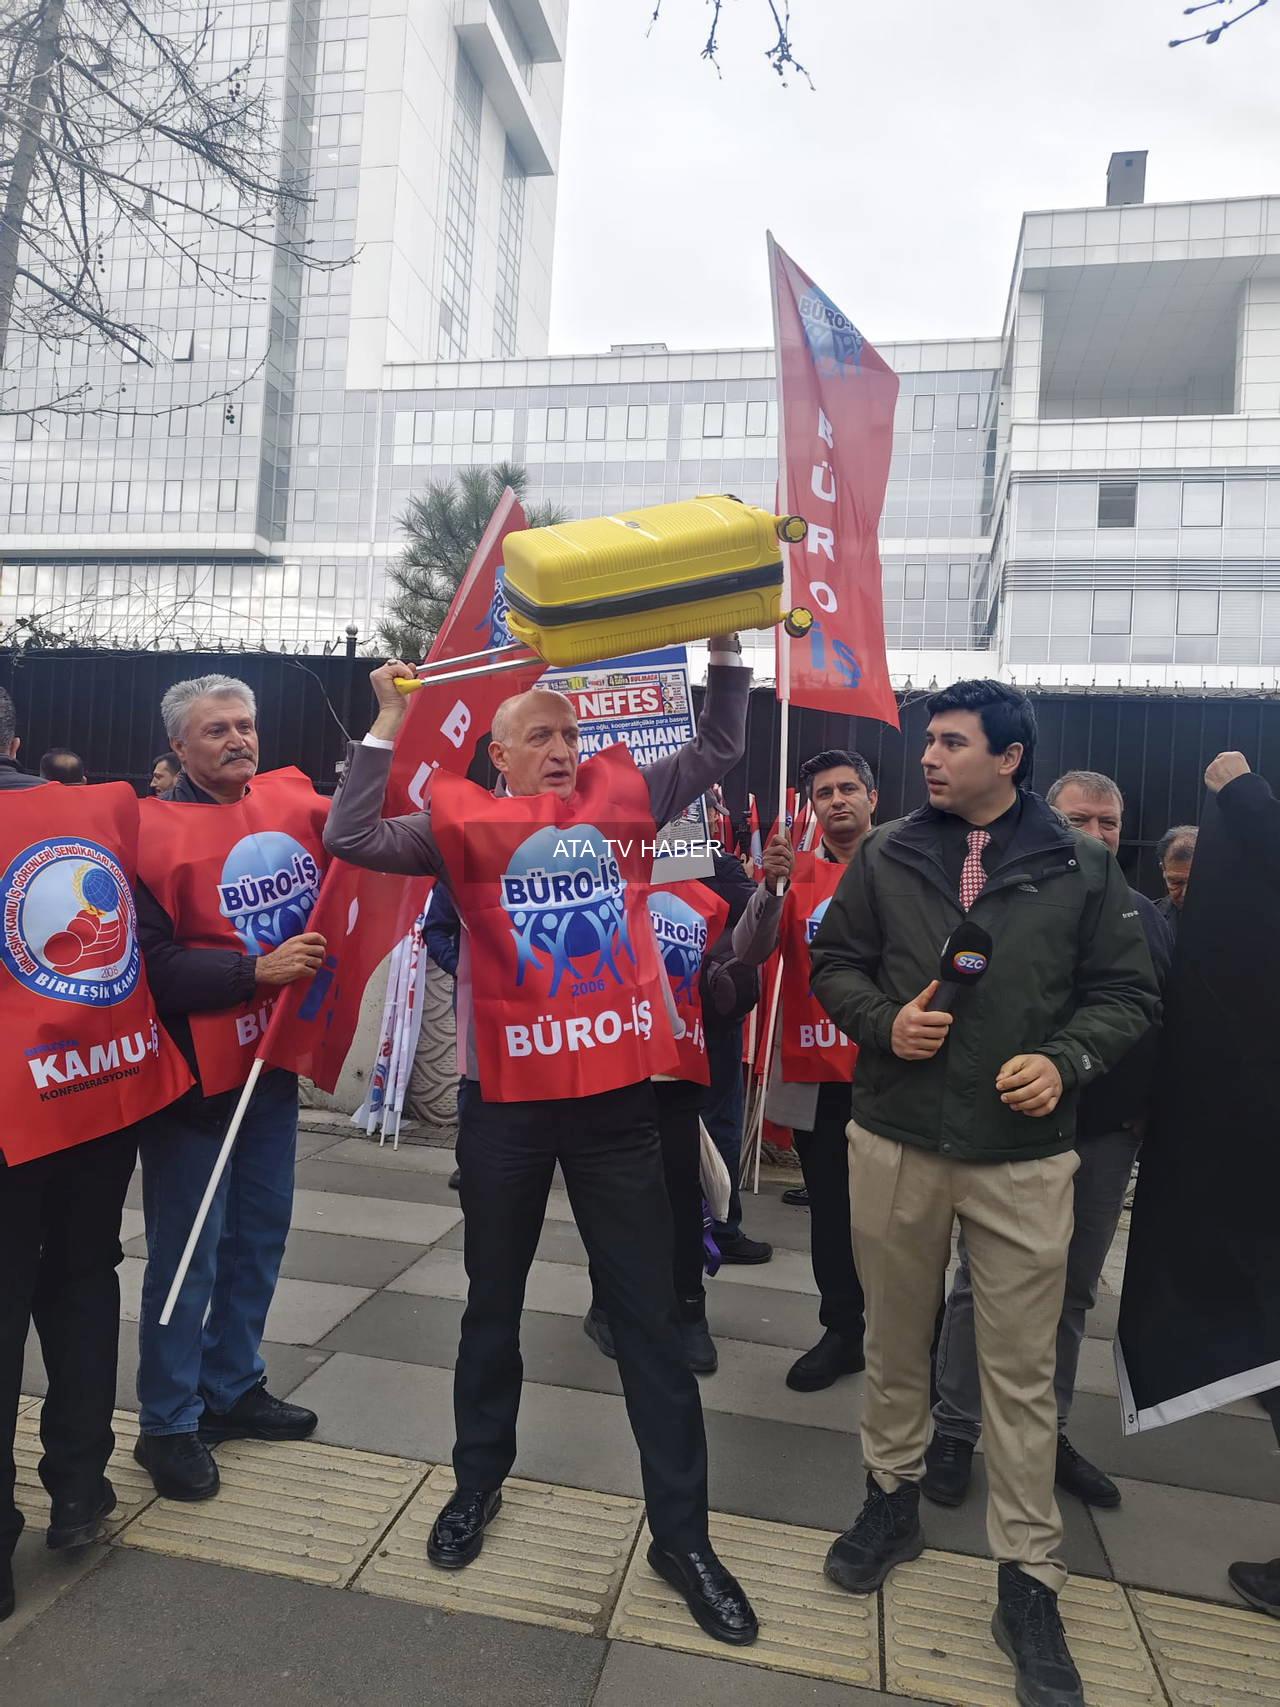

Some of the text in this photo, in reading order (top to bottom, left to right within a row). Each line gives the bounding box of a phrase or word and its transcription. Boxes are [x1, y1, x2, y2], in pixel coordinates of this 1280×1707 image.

[579, 688, 659, 718] NEFES
[617, 724, 690, 748] BAHANE
[14, 846, 55, 888] GÖRENLERİ
[55, 844, 110, 868] SENDİKALARI
[222, 855, 318, 911] BÜRO-İŞ
[504, 856, 621, 905] BÜRO-İŞ
[5, 903, 19, 931] KAMU
[7, 932, 37, 975] BİRLEŞİK
[957, 955, 985, 971] SZC
[34, 973, 111, 1000] BİRLEŞİK
[571, 978, 606, 997] 2006
[505, 996, 653, 1057] BÜRO-İŞ
[40, 1066, 140, 1102] KONFEDERASYONU
